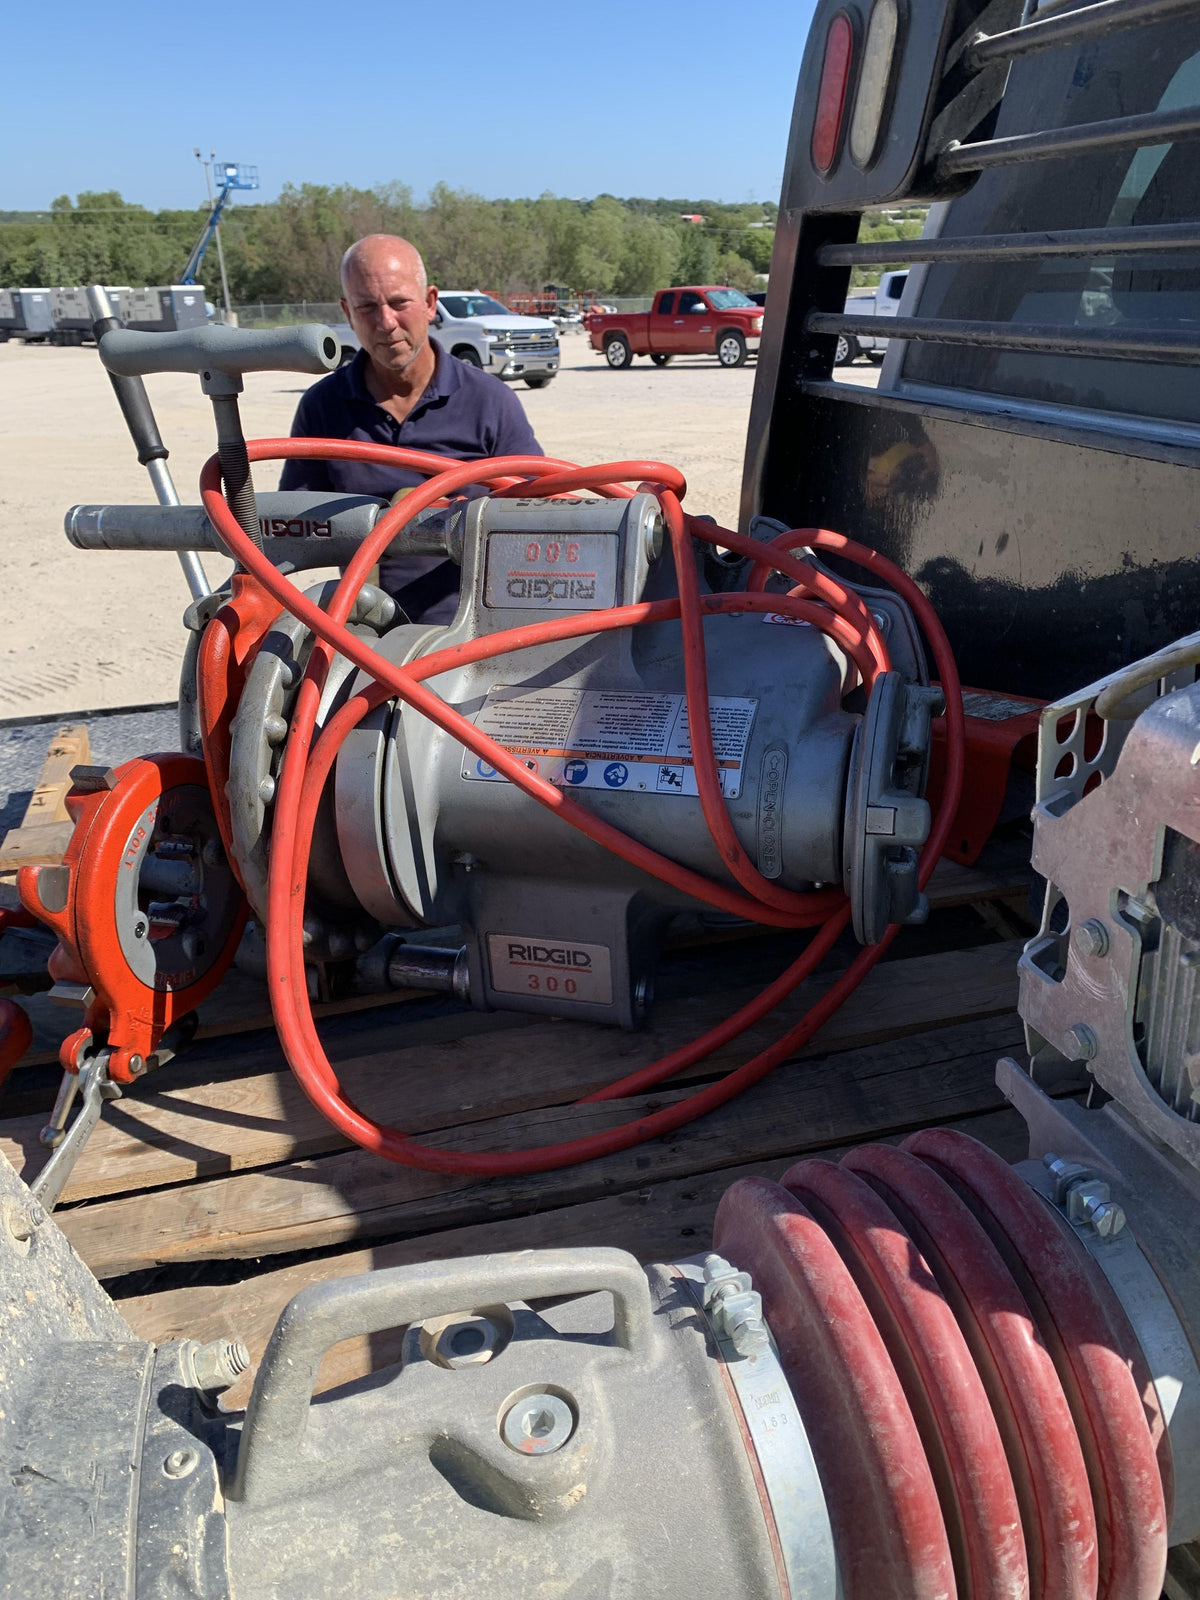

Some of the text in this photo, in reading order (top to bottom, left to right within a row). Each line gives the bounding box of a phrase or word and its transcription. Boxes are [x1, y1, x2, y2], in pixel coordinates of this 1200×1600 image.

[261, 519, 332, 538] RIDGI
[526, 542, 581, 563] 300
[506, 578, 596, 599] RIDGID
[583, 751, 634, 760] ADVERTENCIA
[125, 826, 146, 870] BOLT
[508, 943, 592, 967] RIDGID
[528, 974, 577, 994] 300
